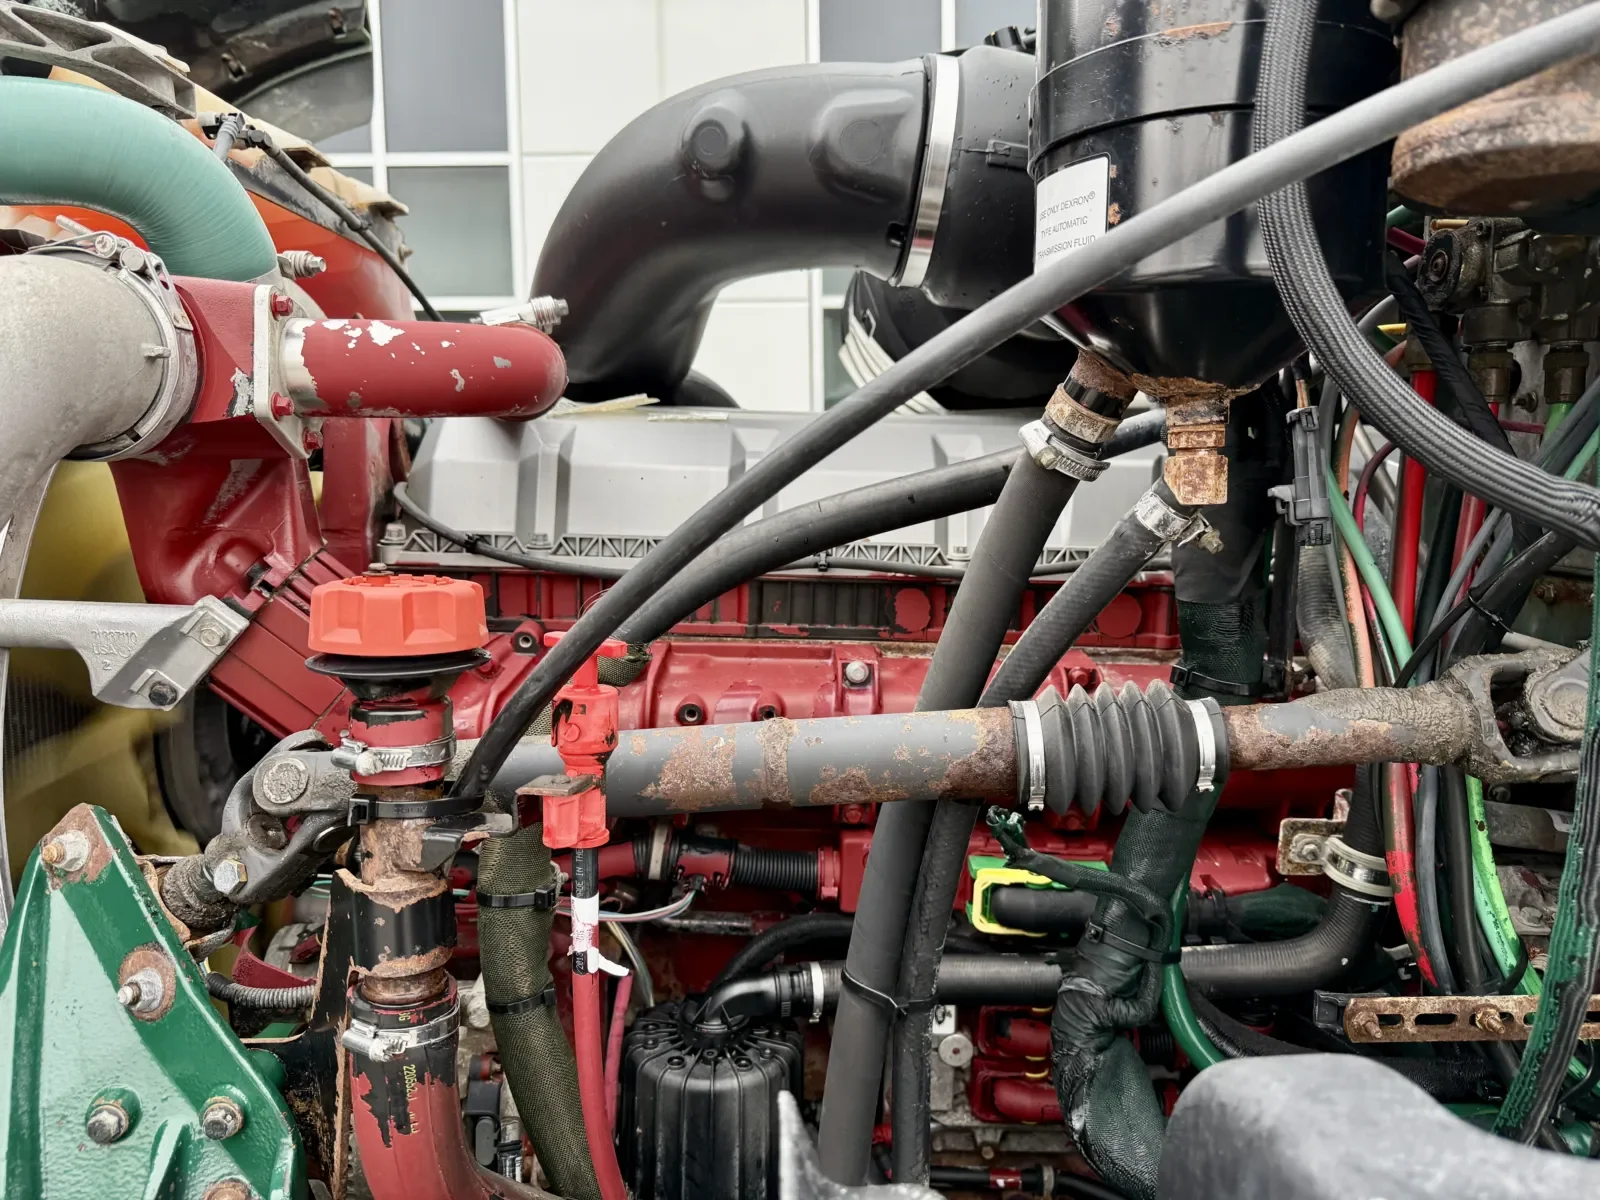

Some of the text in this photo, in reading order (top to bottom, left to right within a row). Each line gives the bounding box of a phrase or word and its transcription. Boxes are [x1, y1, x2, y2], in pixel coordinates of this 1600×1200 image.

[1047, 204, 1060, 217] ONLY
[1041, 215, 1088, 239] TYPE AUTOMATIC
[1073, 234, 1096, 248] FLUID
[92, 643, 118, 656] USA
[575, 848, 584, 862] THE
[575, 866, 584, 877] IN
